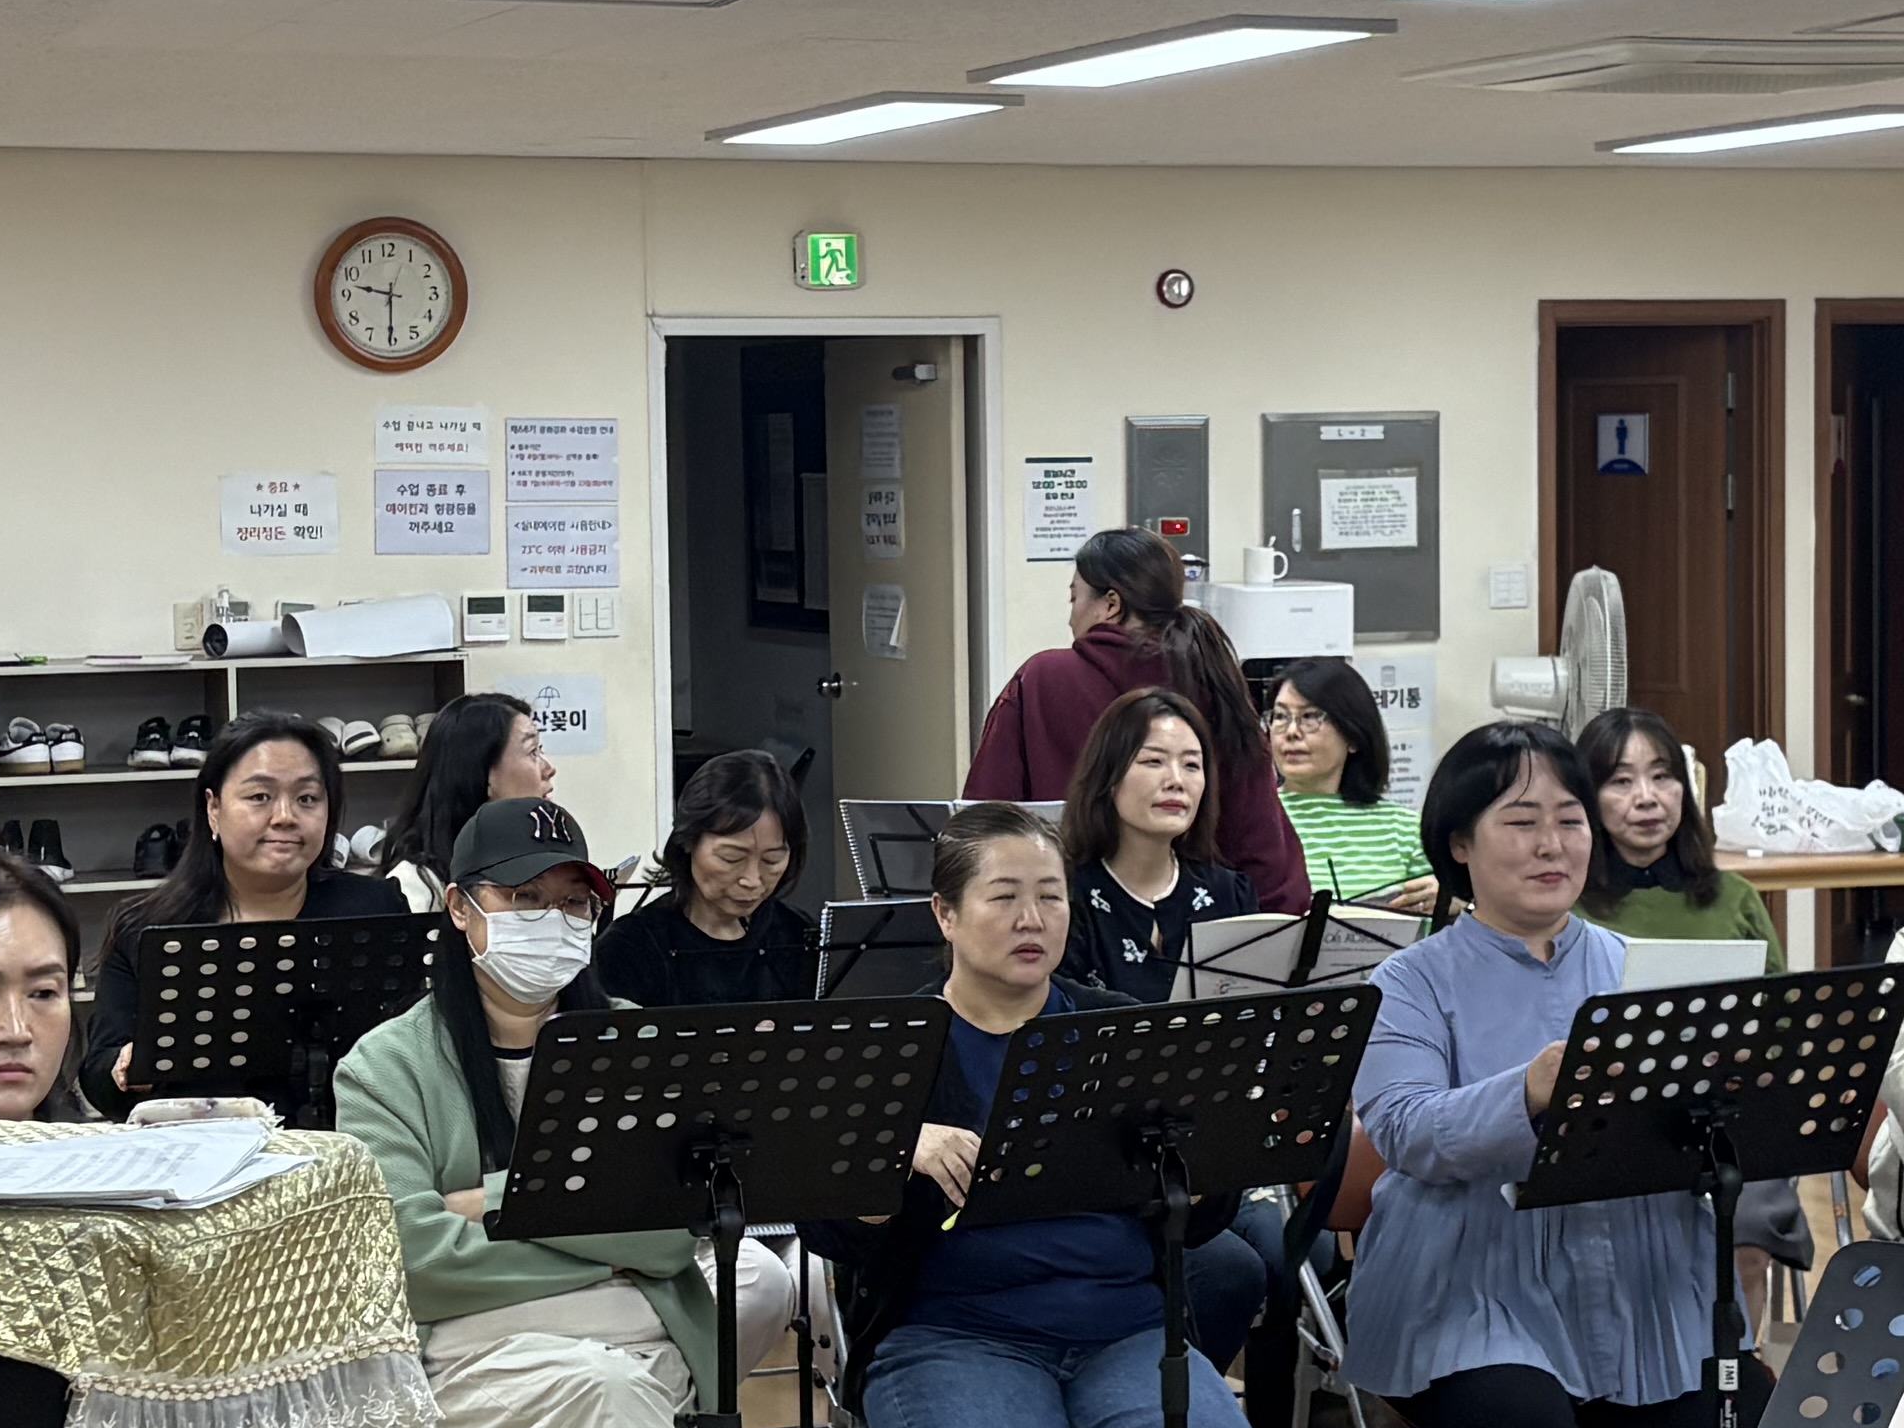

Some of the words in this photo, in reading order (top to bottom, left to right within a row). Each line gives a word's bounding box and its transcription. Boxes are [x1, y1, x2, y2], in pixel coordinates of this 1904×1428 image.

[361, 249, 372, 264] 11
[381, 242, 395, 258] 12
[408, 249, 413, 263] 1
[344, 266, 360, 282] 10
[422, 263, 432, 279] 2
[341, 288, 352, 302] 9
[428, 286, 439, 301] 3
[348, 310, 360, 326] 8
[423, 308, 433, 323] 4
[364, 327, 374, 342] 7
[409, 325, 420, 340] 5
[396, 483, 420, 496] 수업
[426, 483, 448, 497] 종료
[455, 483, 467, 496] 후
[249, 503, 287, 517] 나가실
[294, 502, 309, 517] 때
[236, 526, 287, 541] 정리정돈
[293, 525, 323, 540] 확인!
[408, 521, 455, 534] 꺼주세요
[569, 544, 607, 556] 사용금지
[1372, 687, 1422, 709] 레기통
[532, 709, 588, 732] 산꽂이
[530, 805, 573, 843] NY
